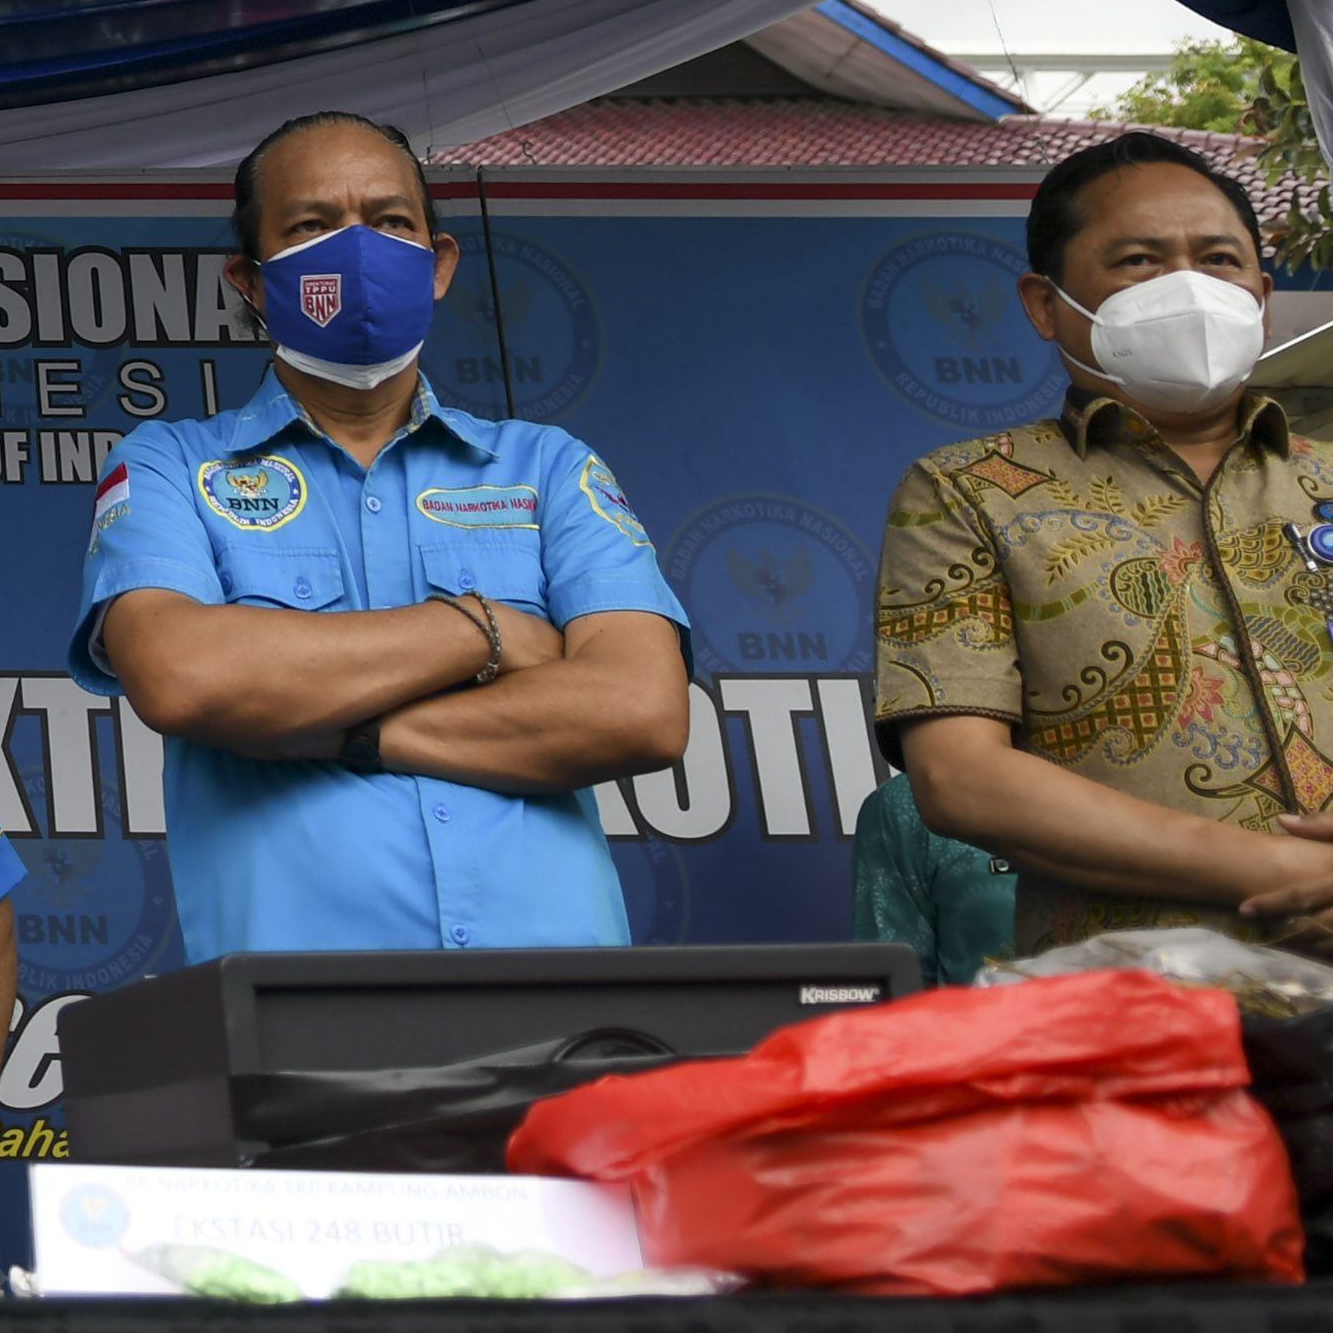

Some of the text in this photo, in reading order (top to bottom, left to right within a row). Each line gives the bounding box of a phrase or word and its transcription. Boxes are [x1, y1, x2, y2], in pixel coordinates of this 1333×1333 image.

[305, 285, 336, 294] TPPU
[304, 294, 337, 323] BNN
[934, 356, 1022, 384] BNN
[226, 497, 279, 512] BNN
[422, 498, 453, 513] BADAN
[454, 500, 507, 513] NARKOTIKA
[737, 631, 829, 661] BNN
[18, 914, 109, 946] BNN
[65, 933, 154, 991] INDONESIA
[800, 987, 875, 1004] KRISBOW
[157, 1175, 277, 1195] NARKOTIKA
[284, 1178, 320, 1196] TKP
[327, 1179, 439, 1199] KAMPUNG
[445, 1183, 529, 1202] AMBON
[173, 1216, 465, 1246] EKSTASI 248 BUTIR
